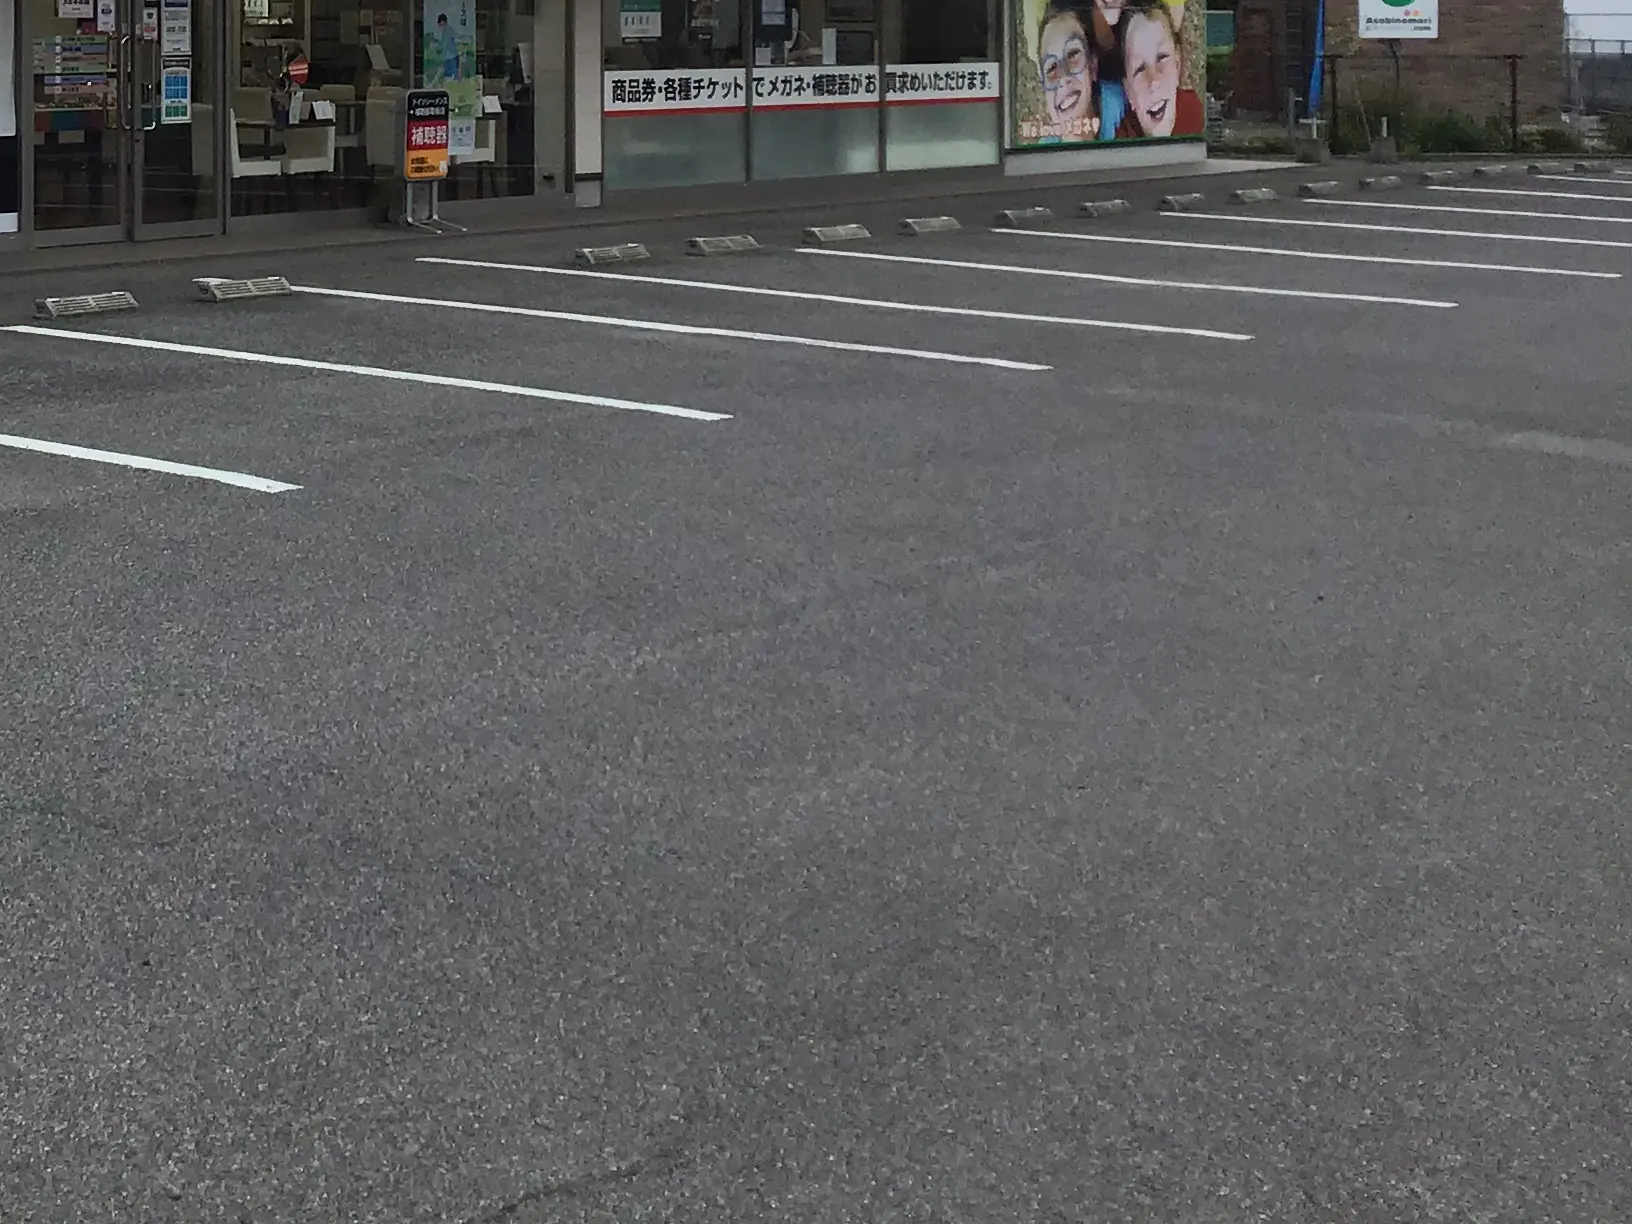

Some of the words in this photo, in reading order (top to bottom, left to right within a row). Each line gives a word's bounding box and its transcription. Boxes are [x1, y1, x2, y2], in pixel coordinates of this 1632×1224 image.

[611, 76, 744, 104] 商品券・各種チケット
[412, 125, 447, 146] 補聴器
